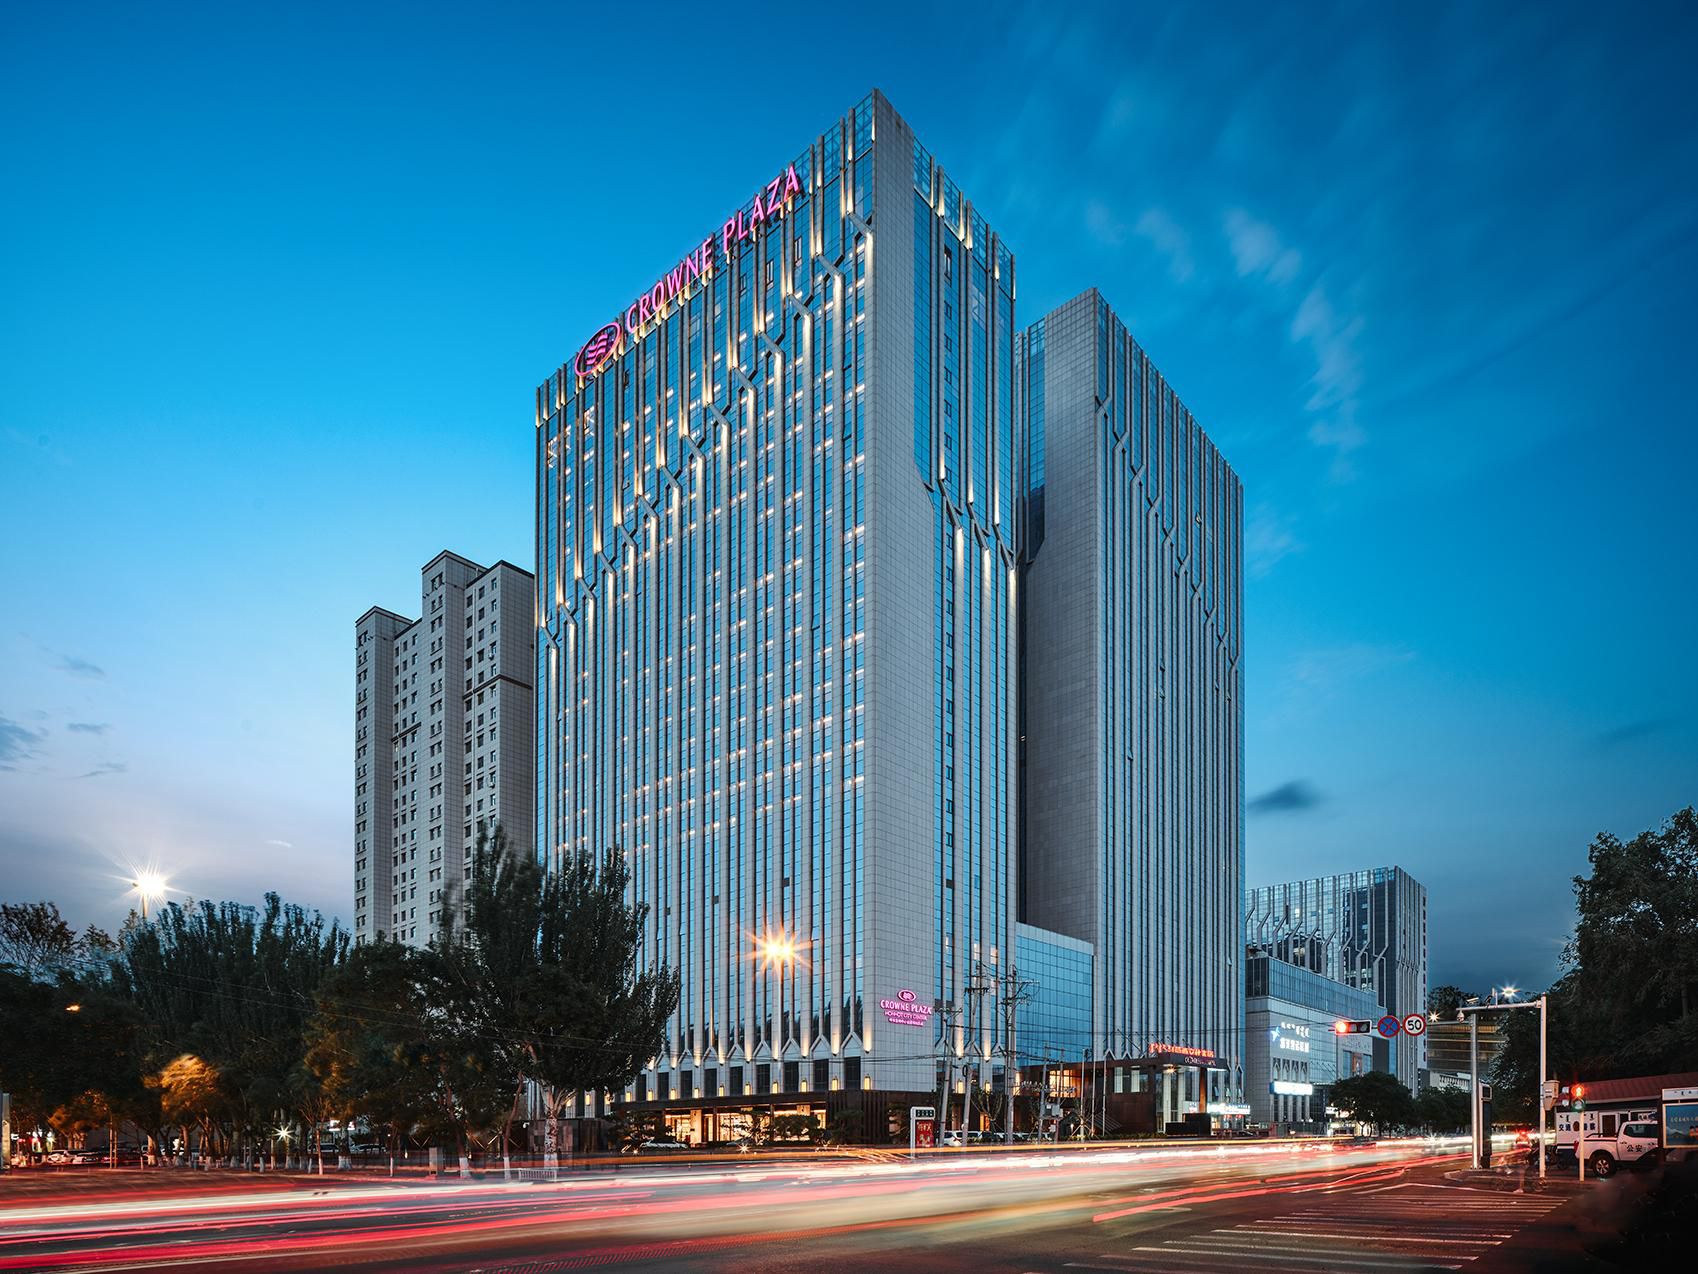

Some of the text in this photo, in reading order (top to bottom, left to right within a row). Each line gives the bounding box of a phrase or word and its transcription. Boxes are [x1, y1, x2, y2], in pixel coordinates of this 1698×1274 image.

[626, 165, 800, 333] CROWNE PLAZA
[880, 1000, 933, 1015] CROWNE PLAZA
[1407, 1019, 1422, 1031] 50
[1626, 1144, 1643, 1152] 公安
